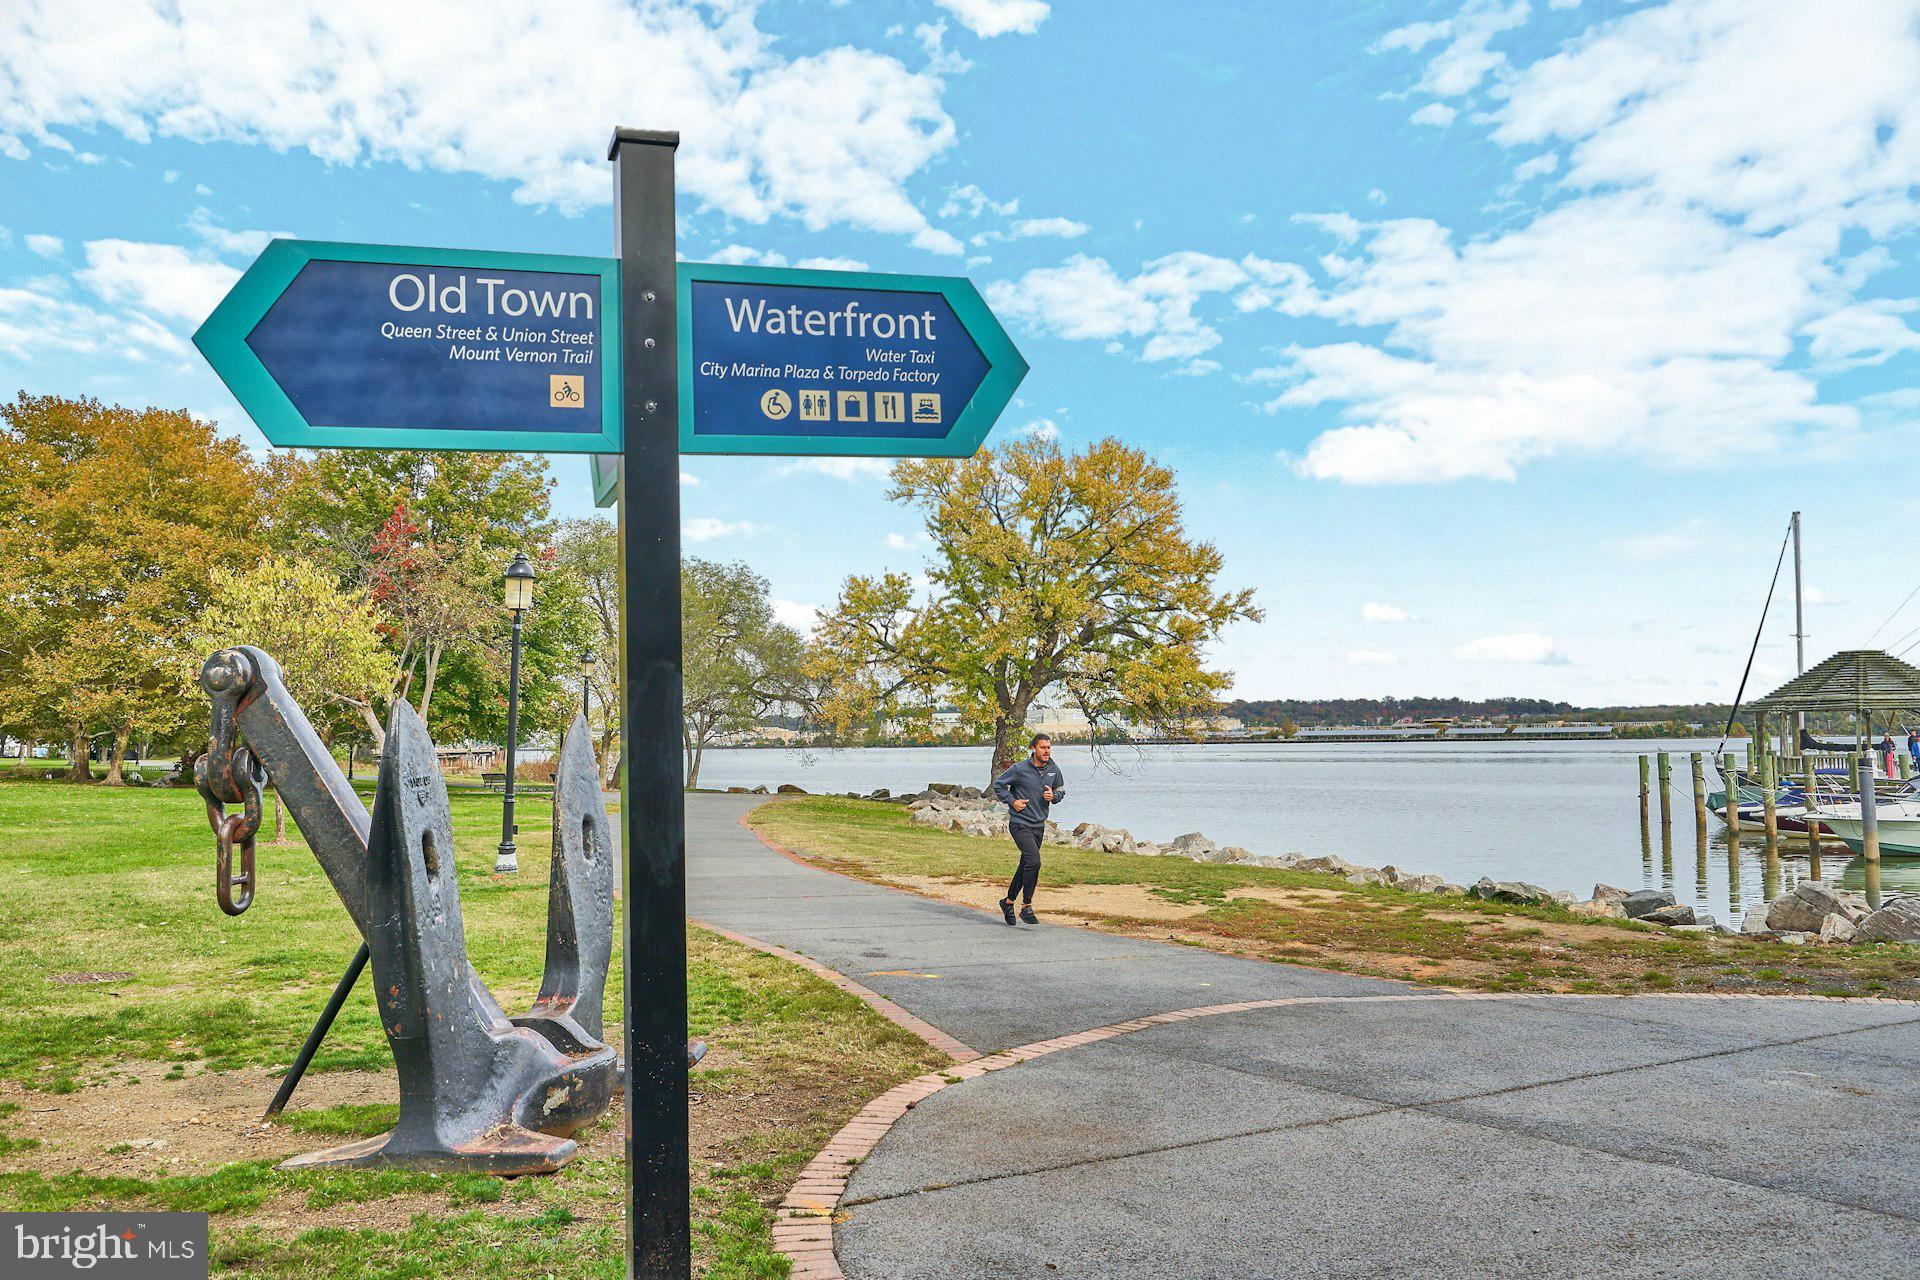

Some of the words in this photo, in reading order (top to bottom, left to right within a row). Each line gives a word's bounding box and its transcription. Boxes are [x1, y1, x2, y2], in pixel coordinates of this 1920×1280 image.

[389, 273, 467, 314] Old
[476, 278, 593, 319] Town
[724, 298, 936, 341] Waterfront
[381, 322, 432, 339] Queen
[436, 324, 482, 341] Street
[485, 326, 498, 341] &
[502, 327, 547, 343] Union
[550, 328, 594, 345] Street
[449, 345, 501, 361] Mount
[505, 347, 557, 363] Vernon
[562, 349, 593, 364] Trail
[865, 348, 906, 364] Water
[909, 350, 935, 364] Taxi
[700, 361, 728, 380] City
[731, 363, 781, 379] Marina
[784, 364, 820, 380] Plaza
[823, 365, 835, 380] &
[838, 366, 890, 383] Torpedo
[893, 367, 940, 385] Factory
